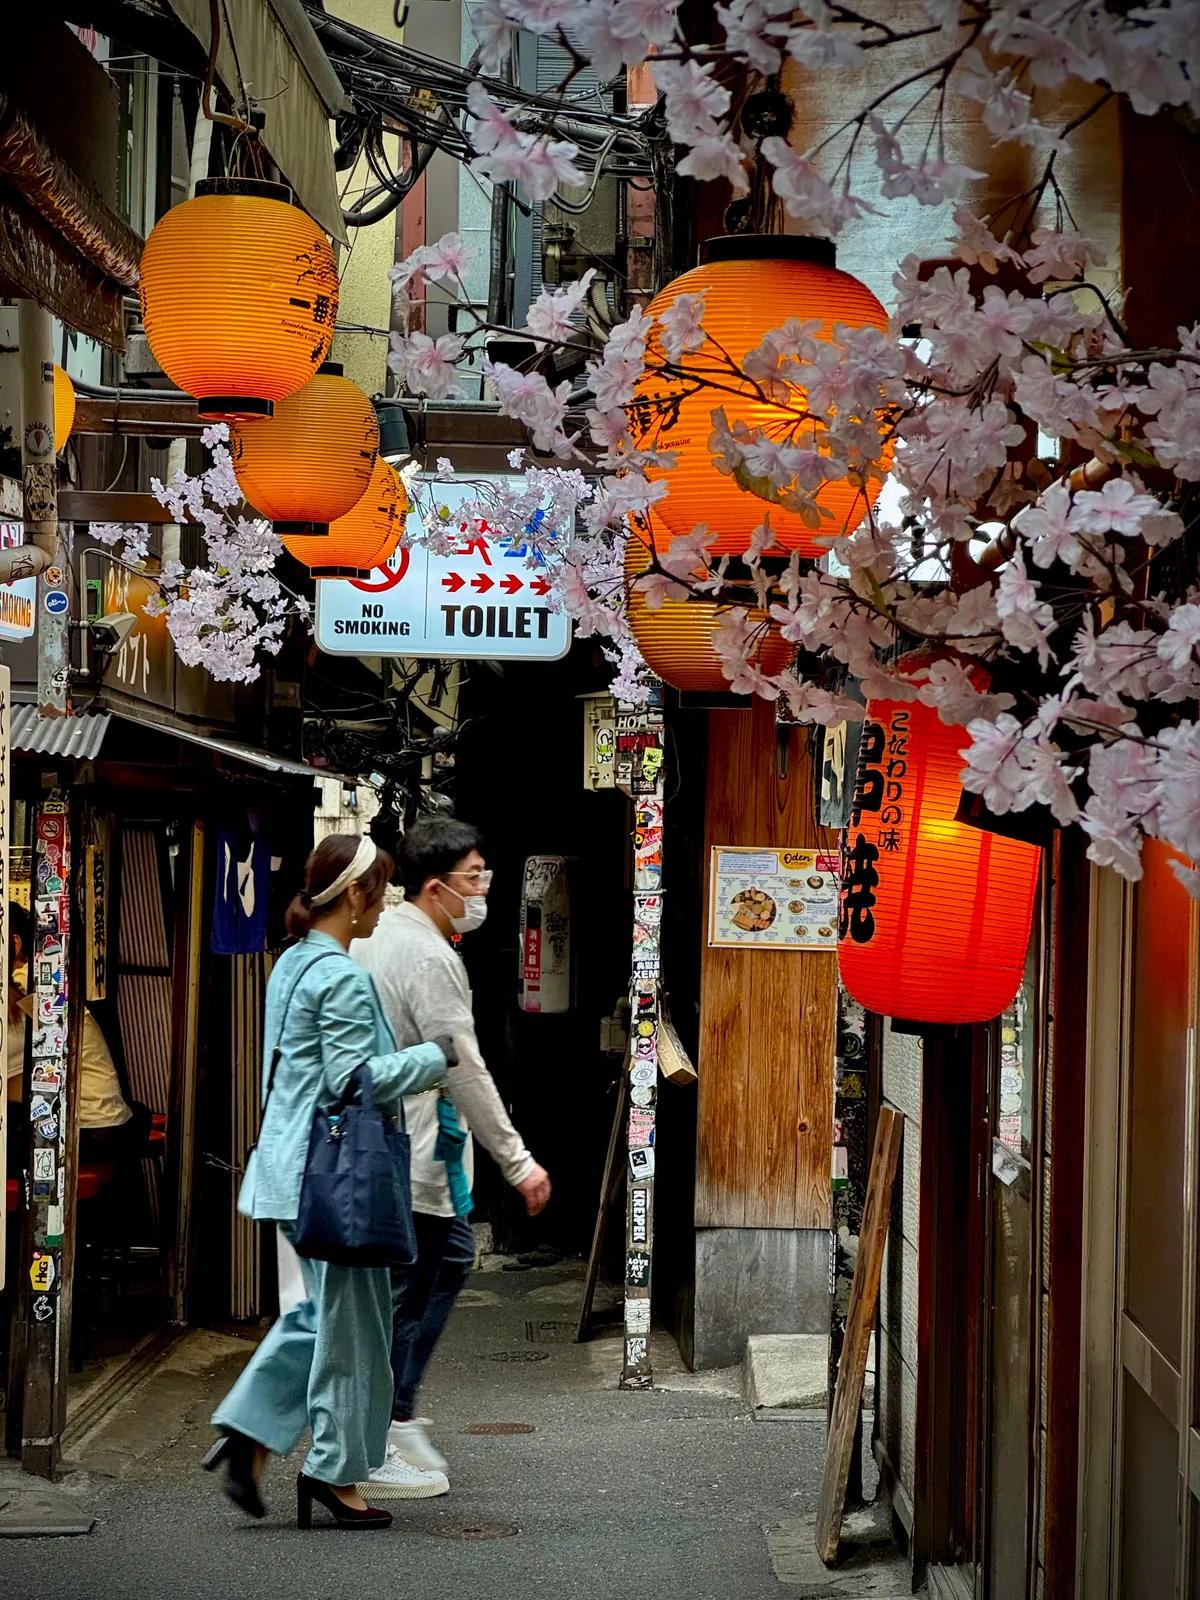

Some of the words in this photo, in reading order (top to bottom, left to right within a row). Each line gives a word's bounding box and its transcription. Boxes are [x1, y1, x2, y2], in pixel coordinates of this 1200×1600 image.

[0, 590, 32, 629] MOKING
[362, 604, 384, 619] NO
[334, 619, 411, 637] SMOKING
[441, 604, 554, 640] TOILET
[877, 711, 911, 854] こだわりの味
[783, 852, 812, 865] Oden
[528, 928, 538, 965] 消火器
[628, 1257, 649, 1267] LOVE
[630, 1271, 645, 1279] 人生
